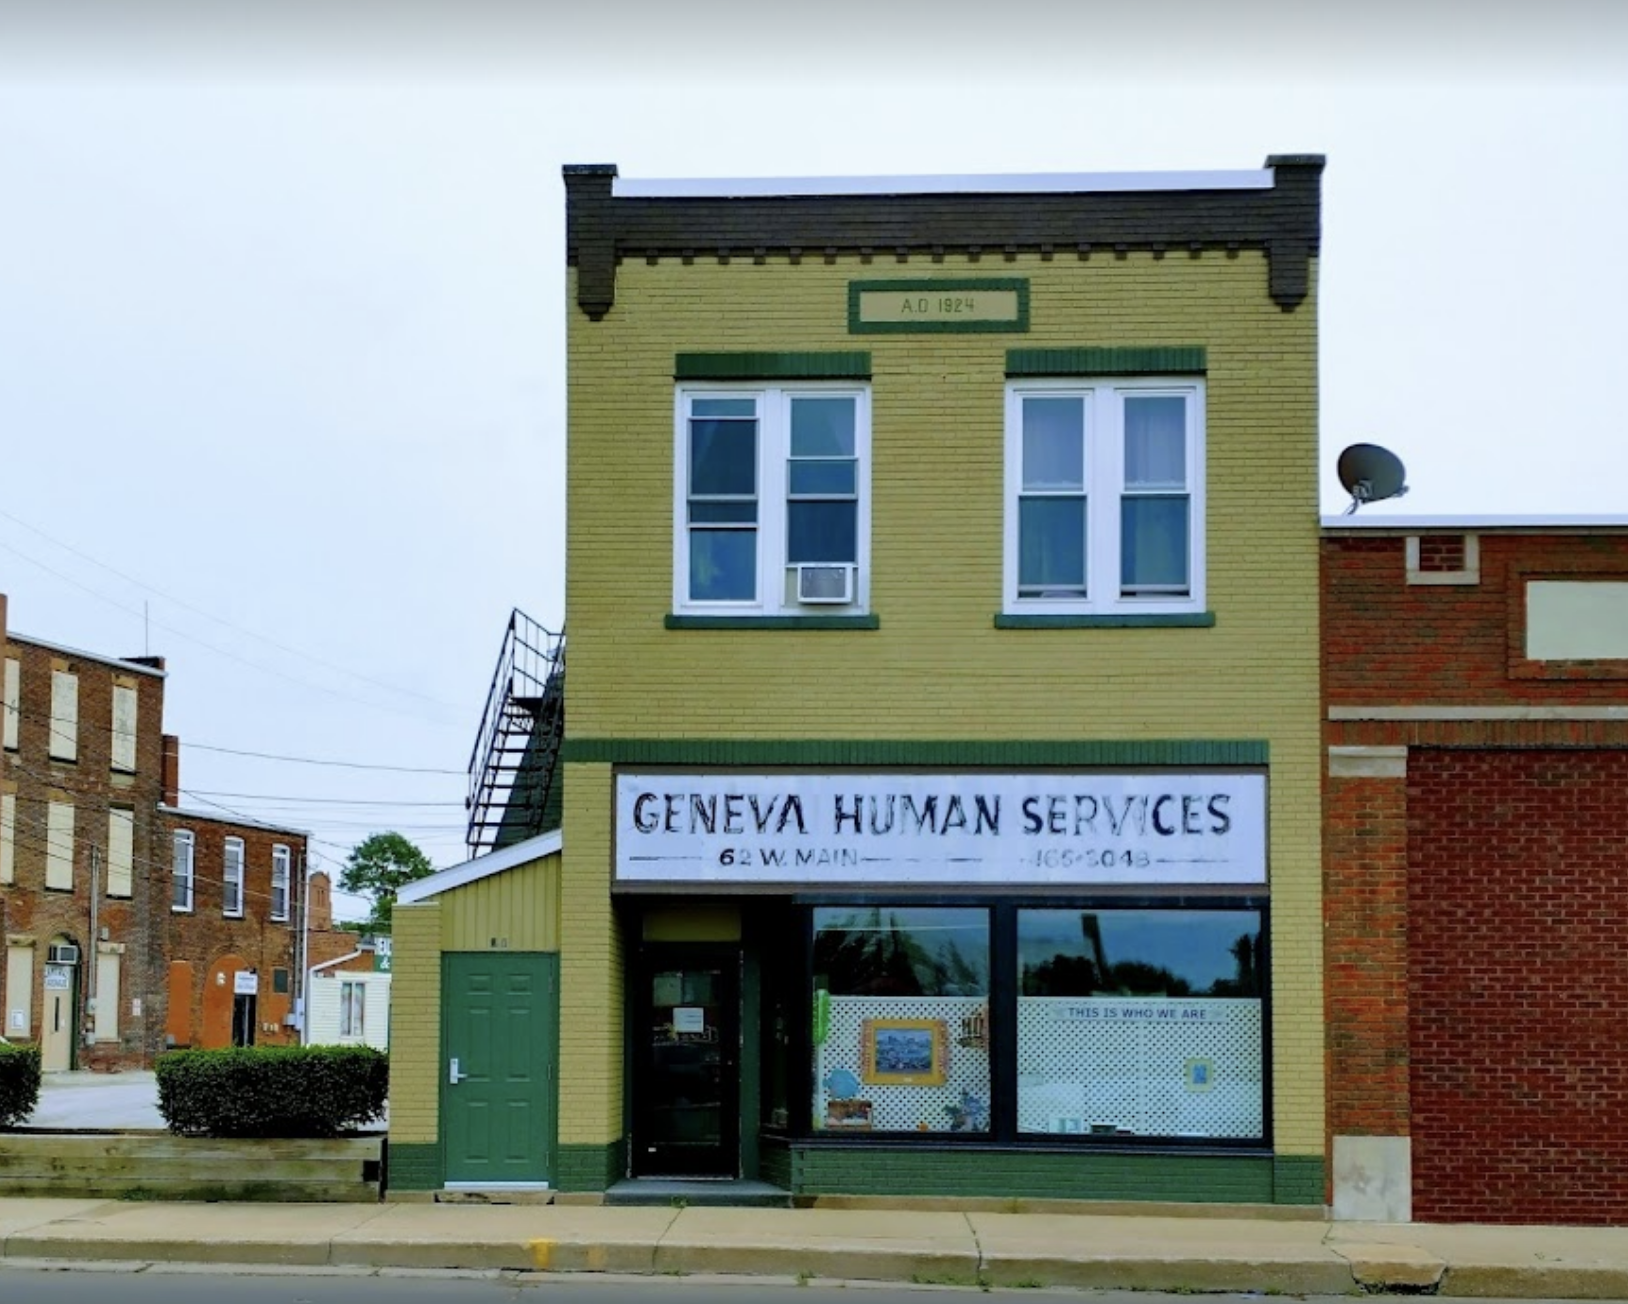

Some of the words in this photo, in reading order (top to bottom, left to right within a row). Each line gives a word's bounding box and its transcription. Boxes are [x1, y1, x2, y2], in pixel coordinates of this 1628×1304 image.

[939, 298, 974, 313] 1924
[633, 792, 808, 835] GENEVA
[834, 793, 1000, 836] HUMAN
[1022, 794, 1231, 836] SERVICES
[719, 848, 751, 867] 62
[795, 848, 857, 867] MAIN
[1068, 1007, 1099, 1018] THIS
[1103, 1007, 1118, 1018] IS
[1122, 1008, 1154, 1018] WHO
[1157, 1008, 1177, 1019] WE
[1181, 1009, 1207, 1019] ARE
